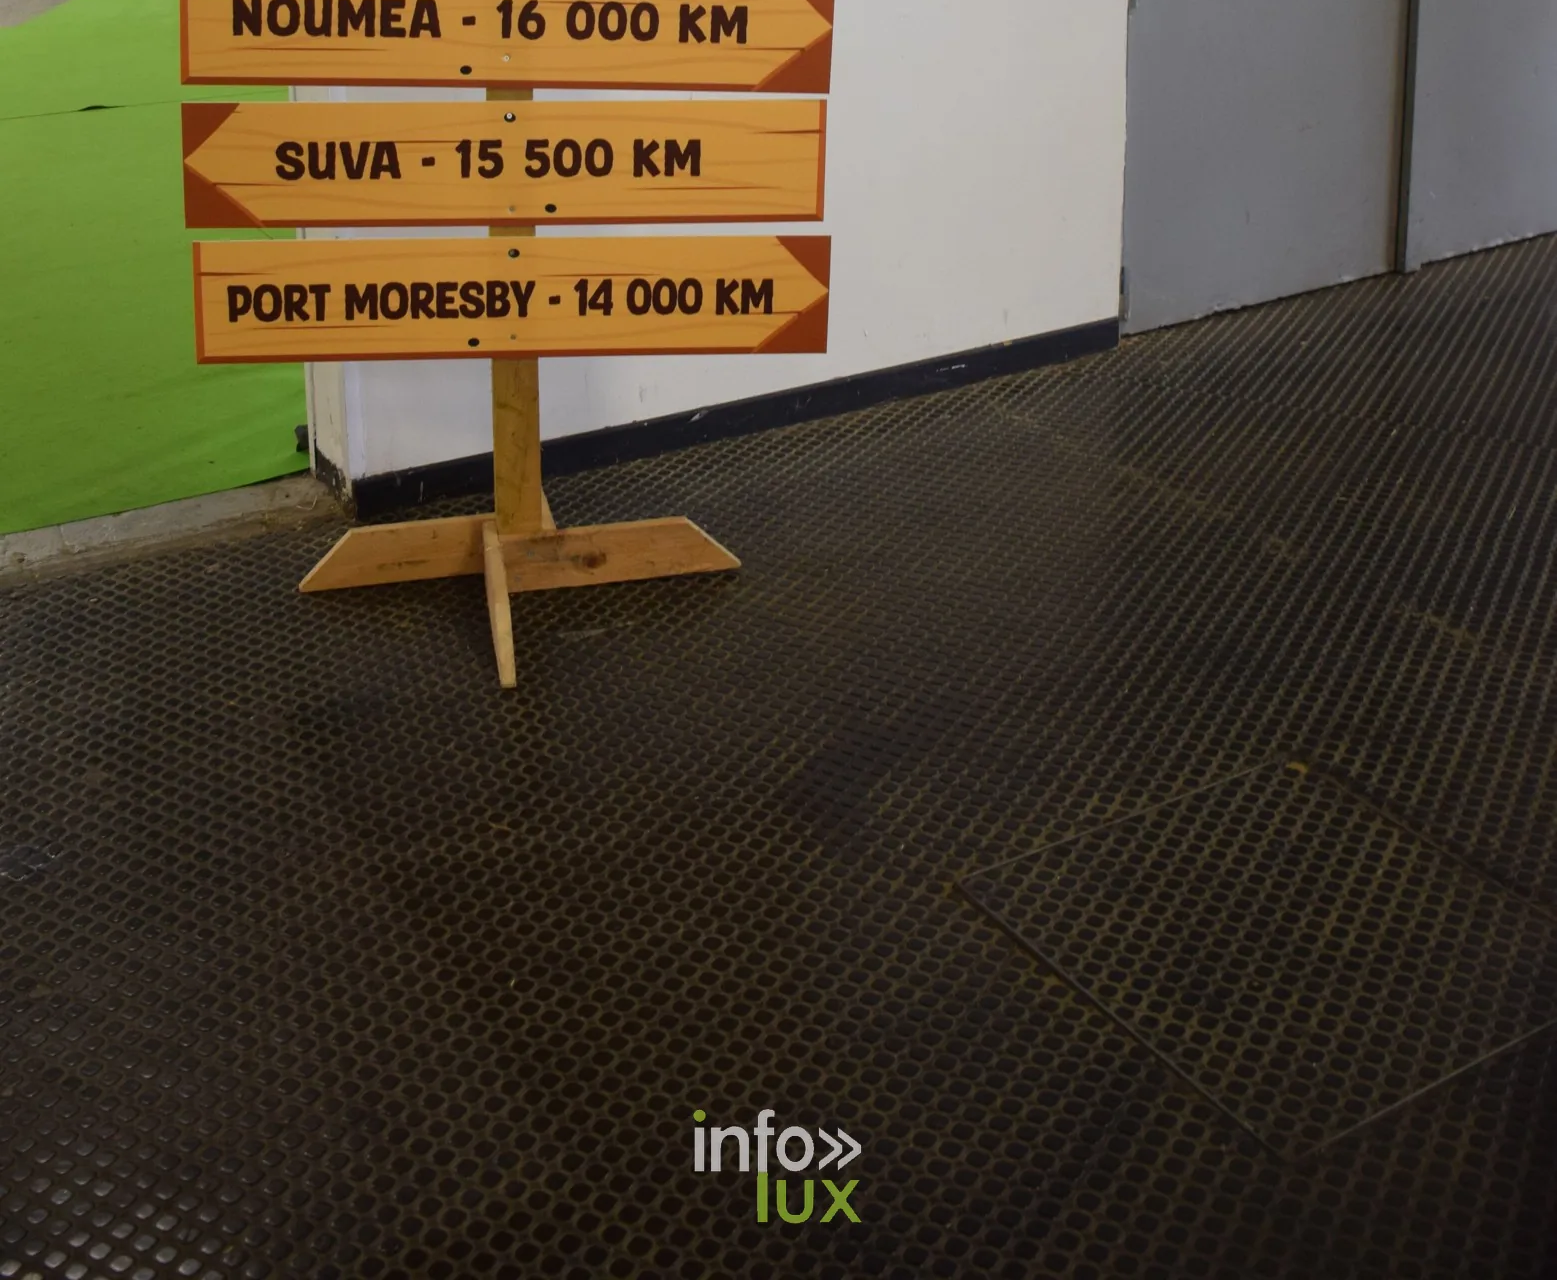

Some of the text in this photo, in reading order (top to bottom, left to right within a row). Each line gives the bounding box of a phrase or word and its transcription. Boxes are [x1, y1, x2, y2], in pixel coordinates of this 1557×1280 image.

[462, 16, 476, 26] -
[496, 0, 546, 41] 16
[565, 0, 660, 42] 000
[678, 3, 748, 45] KM
[275, 138, 702, 181] SUVA - 15 500 KM
[226, 277, 774, 323] PORT MORESBY - 14 000 KM
